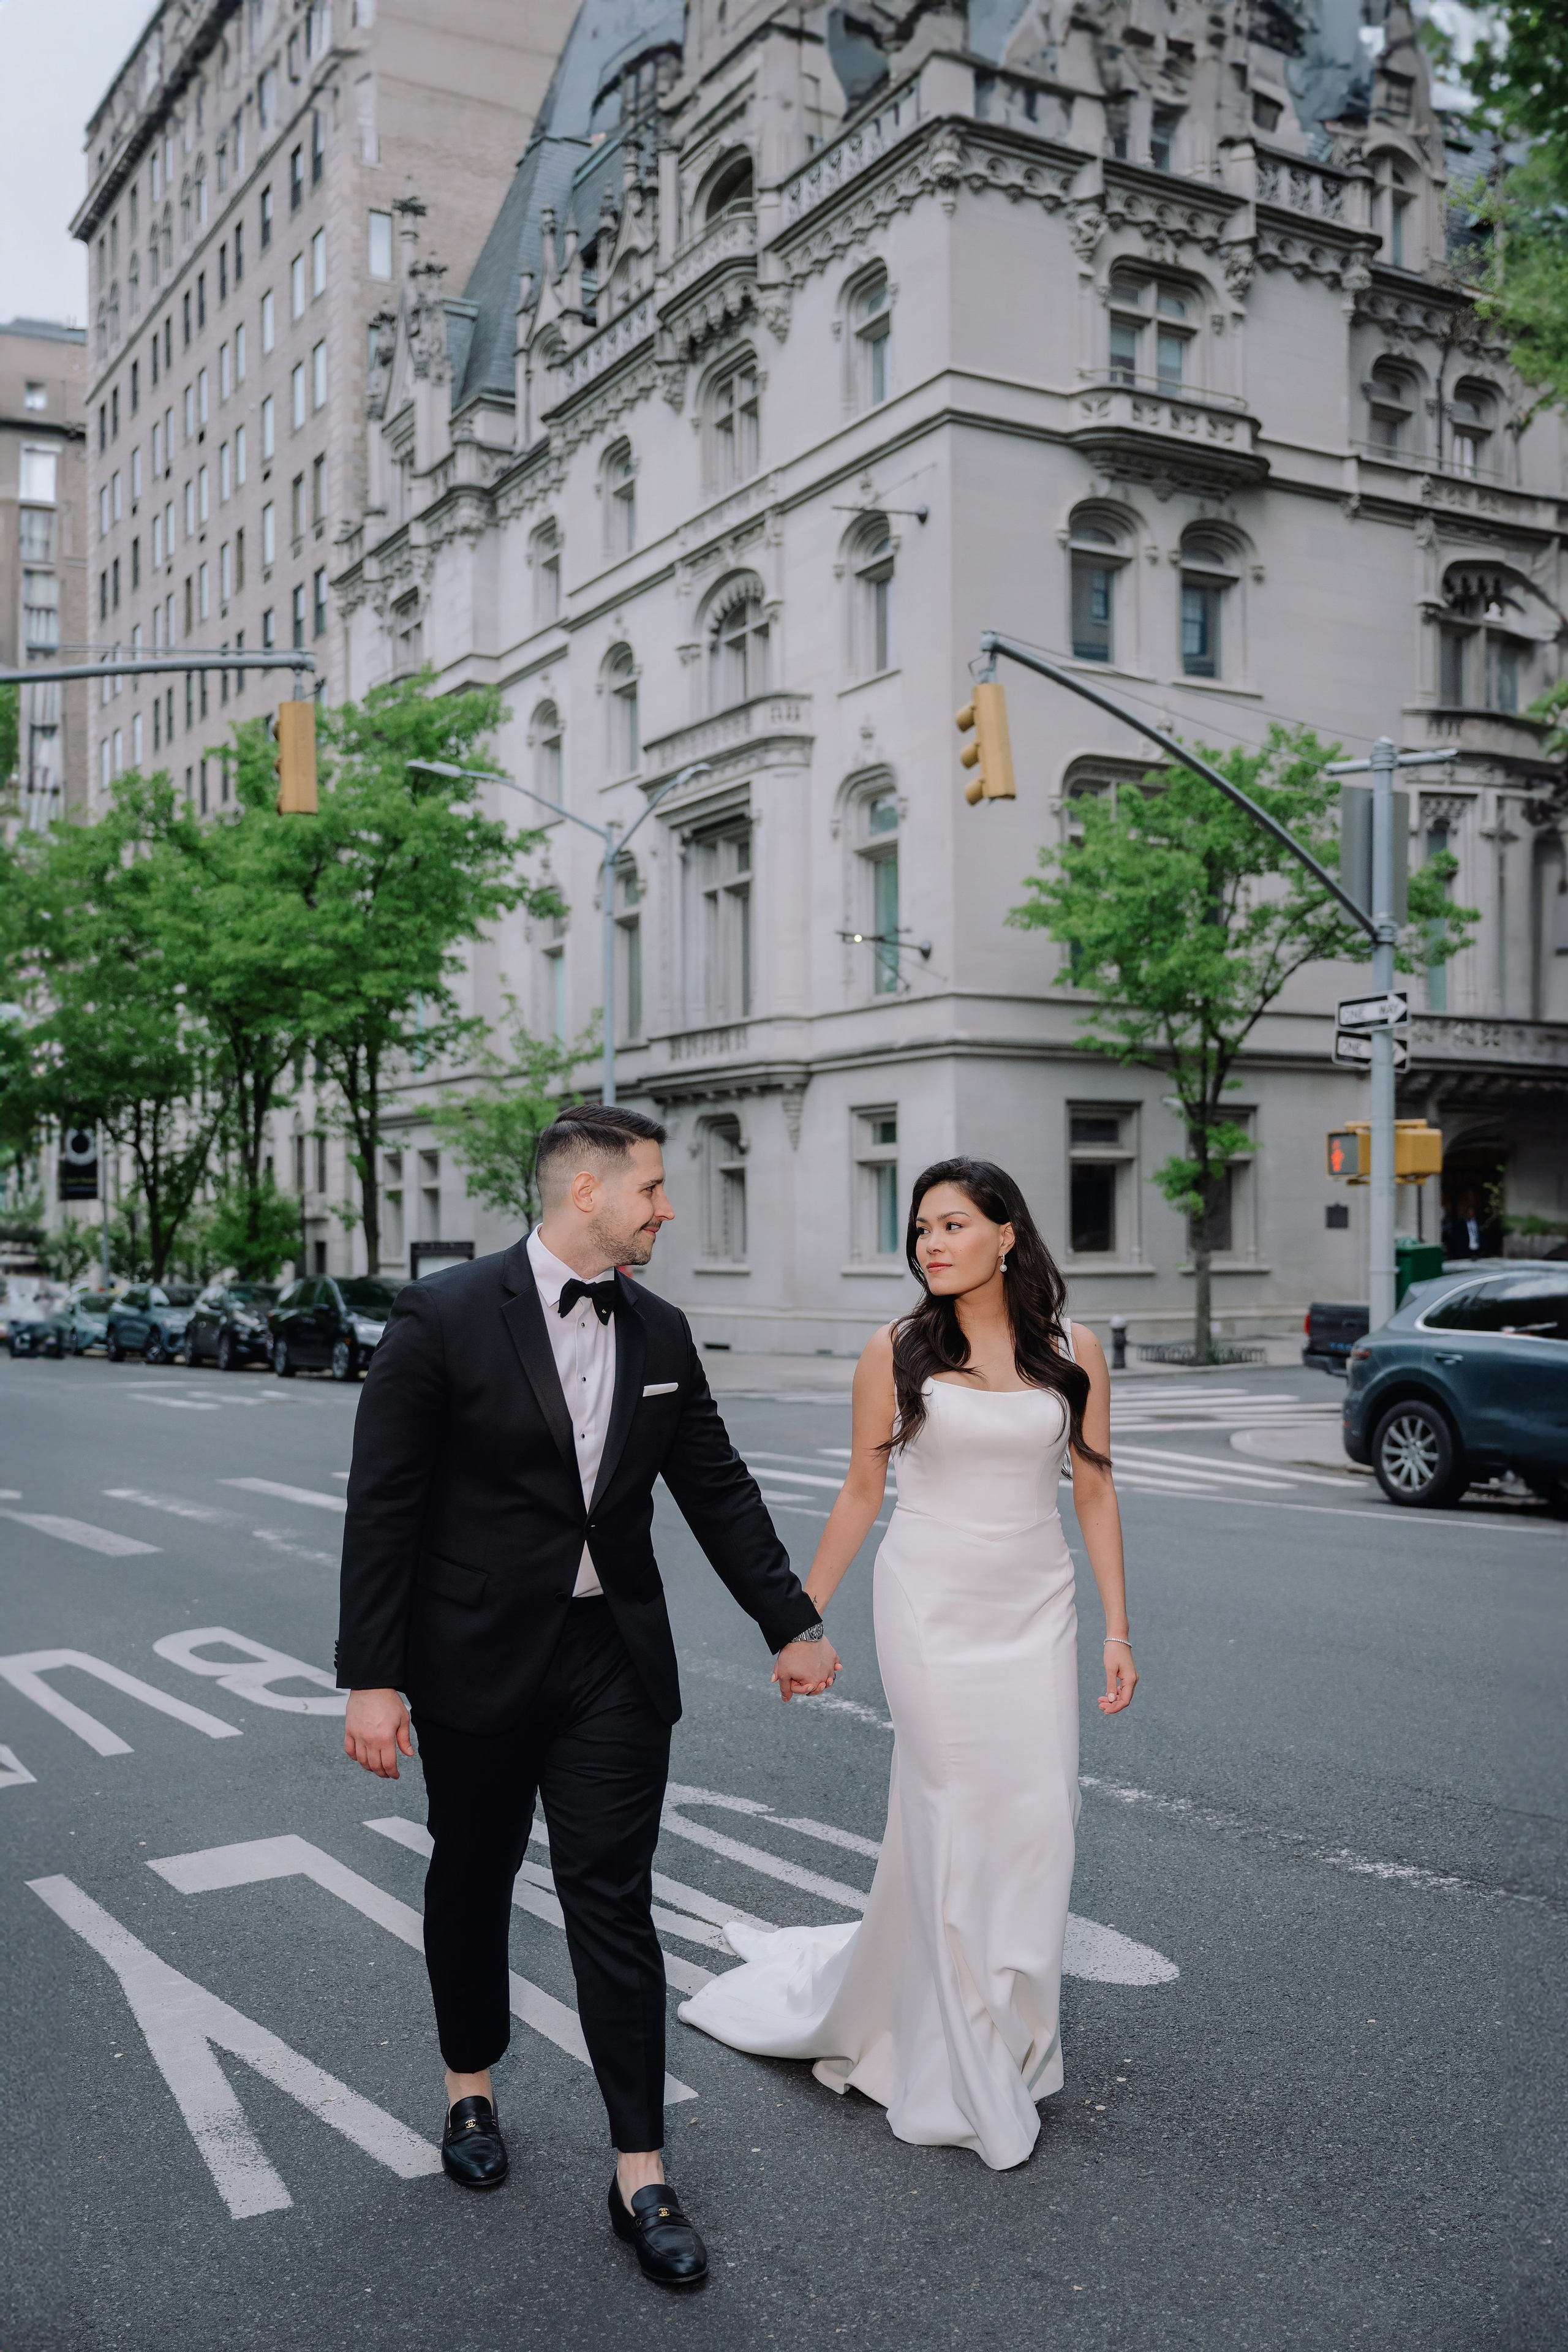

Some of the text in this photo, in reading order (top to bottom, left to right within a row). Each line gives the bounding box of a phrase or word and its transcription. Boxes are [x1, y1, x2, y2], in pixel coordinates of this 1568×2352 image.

[1341, 1001, 1400, 1022] ONE WAY
[1340, 1039, 1362, 1056] ONE
[0, 1626, 412, 1789] BU
